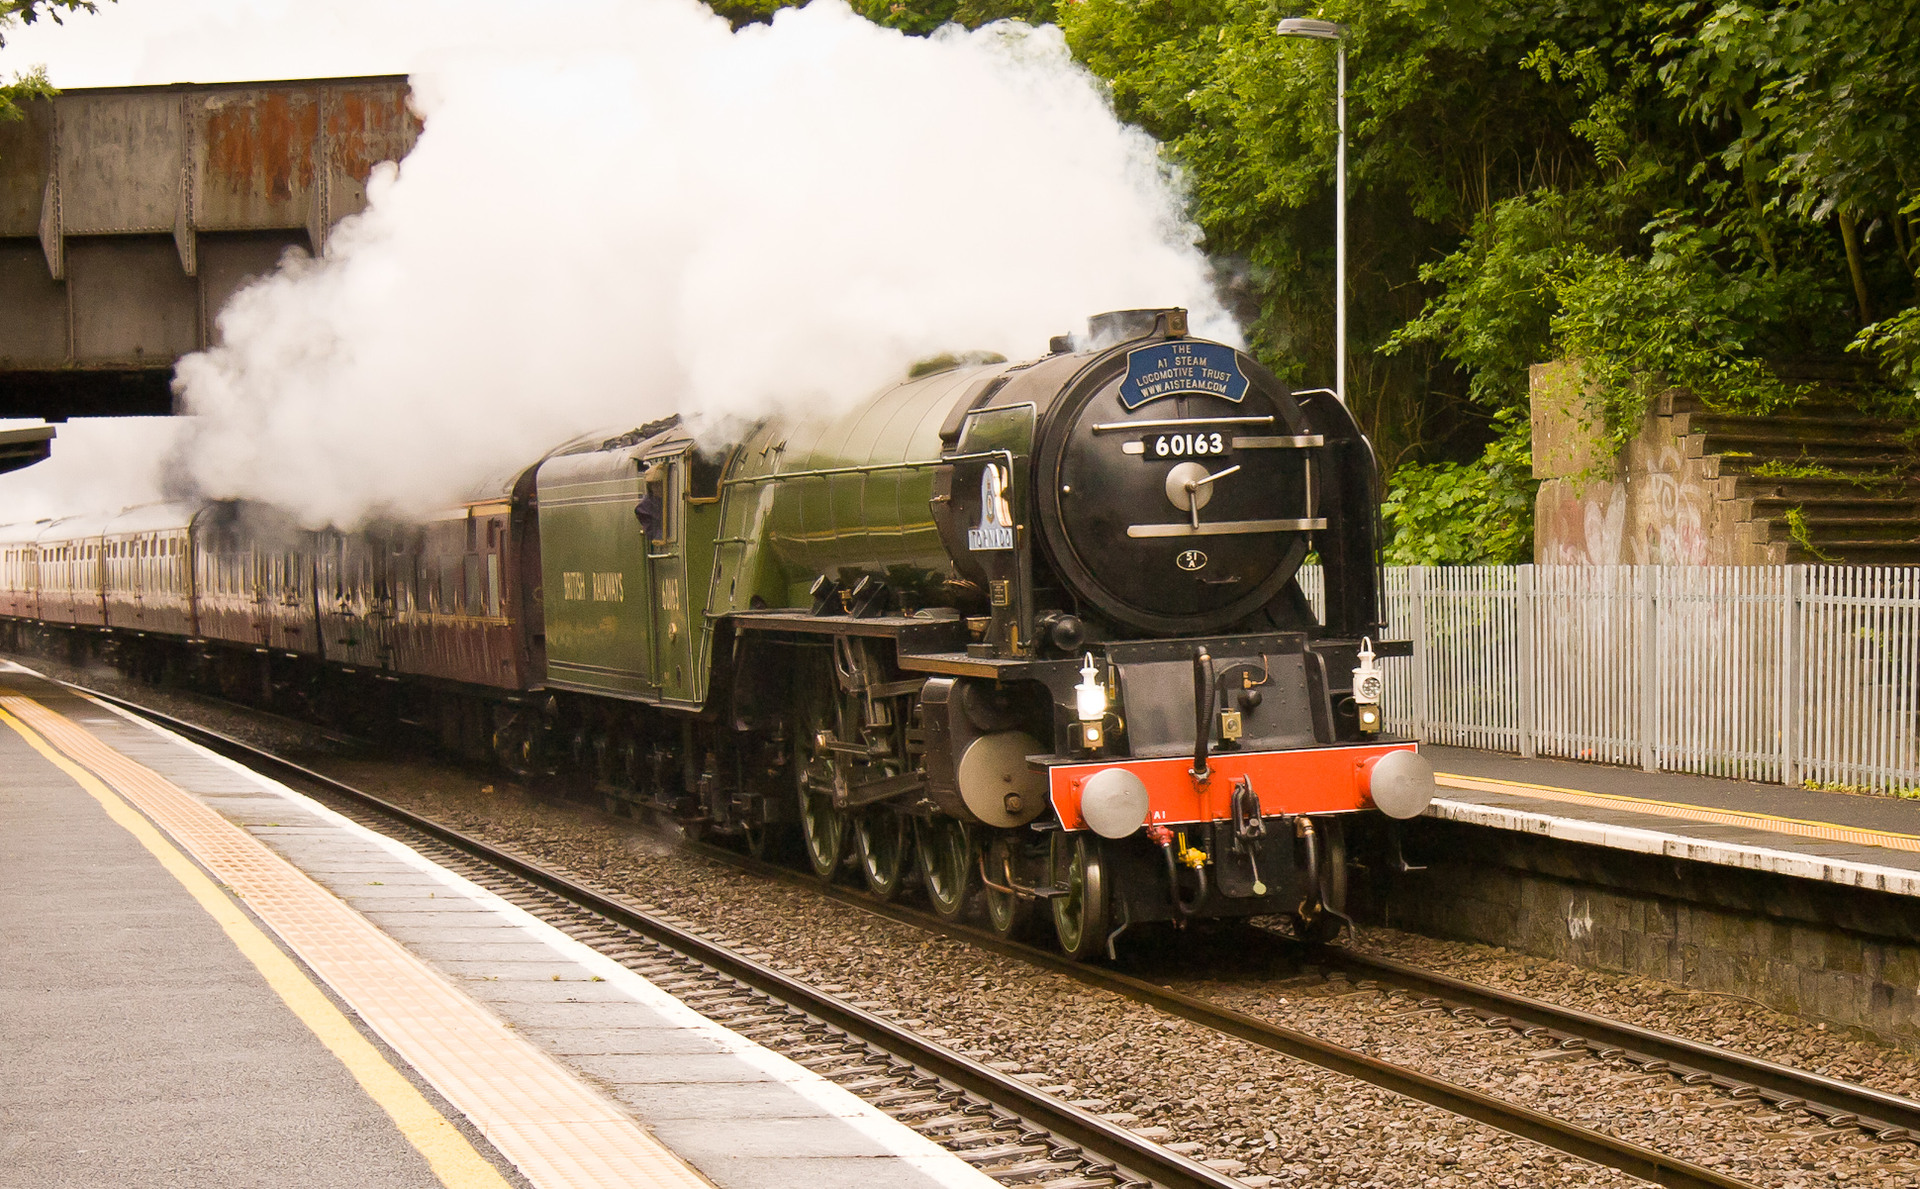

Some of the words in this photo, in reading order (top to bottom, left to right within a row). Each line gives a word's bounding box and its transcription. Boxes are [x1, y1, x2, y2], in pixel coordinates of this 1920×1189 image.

[1171, 344, 1192, 354] THE
[1157, 358, 1168, 369] A1
[1175, 356, 1207, 367] STEAM
[1136, 367, 1194, 387] LOCOMOTIVE
[1201, 367, 1232, 382] TRUST
[1140, 379, 1227, 398] WWW.A1STEAM.COM
[1155, 433, 1224, 457] 60163
[1186, 552, 1197, 561] 51
[563, 571, 586, 601] BRITISH
[592, 572, 624, 602] RAILWAYS
